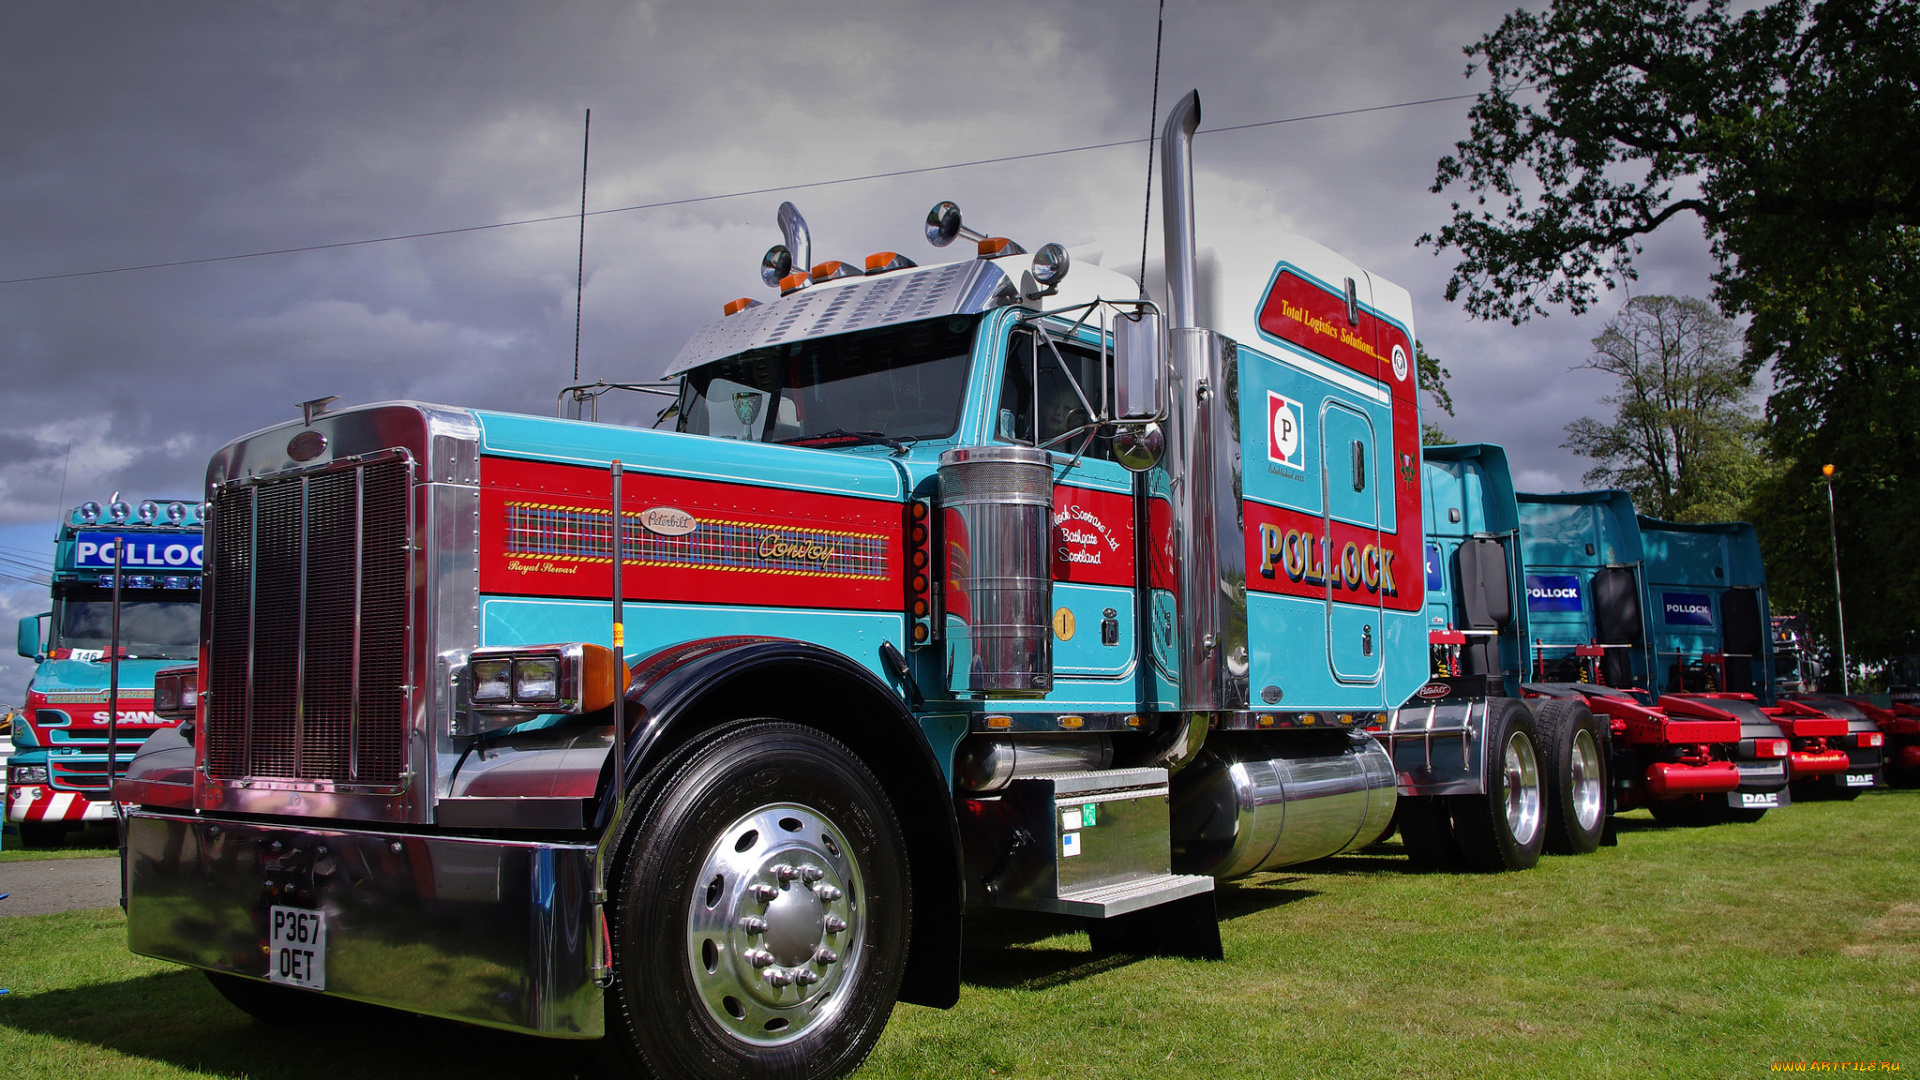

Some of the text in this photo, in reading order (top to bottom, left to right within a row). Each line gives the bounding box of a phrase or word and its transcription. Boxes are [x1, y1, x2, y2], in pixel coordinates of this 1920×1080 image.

[1281, 299, 1303, 322] Total
[1304, 310, 1339, 338] Logistics
[1281, 418, 1292, 442] P
[648, 510, 691, 529] Peterbilt
[1061, 528, 1098, 549] Bathgate
[1104, 528, 1120, 552] Ltd
[1058, 546, 1101, 565] Scotland
[1259, 522, 1398, 596] POLLOCK
[507, 560, 578, 576] Royal Stewart
[1526, 588, 1578, 599] POLLOCK
[1666, 604, 1709, 614] POLLOCK
[76, 651, 98, 661] 146
[1846, 774, 1874, 782] DAF
[1741, 793, 1779, 803] DAF
[274, 910, 320, 945] P367
[280, 947, 315, 981] OET
